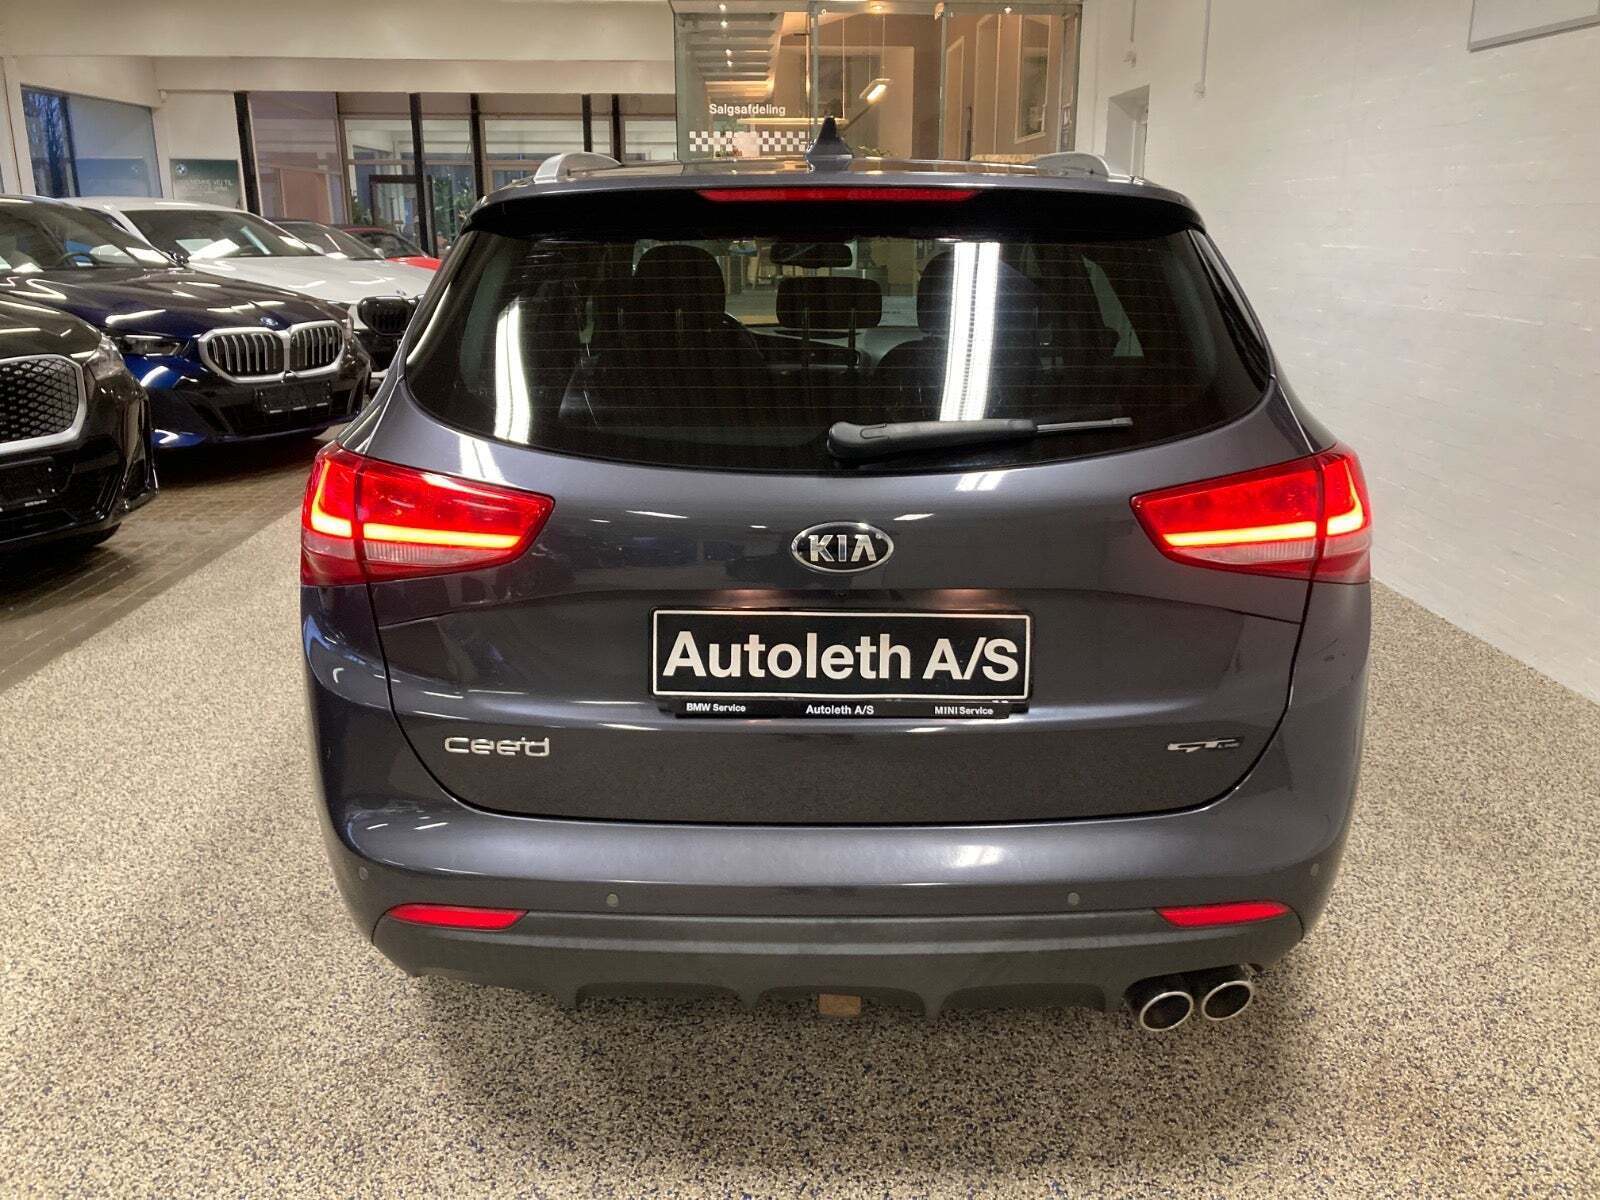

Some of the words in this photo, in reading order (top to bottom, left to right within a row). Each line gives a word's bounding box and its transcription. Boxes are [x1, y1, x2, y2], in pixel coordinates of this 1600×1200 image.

[709, 103, 786, 117] Salgsafdeling
[808, 534, 877, 562] KIA
[662, 630, 911, 680] Autoleth
[922, 636, 1019, 682] A/S
[686, 703, 711, 712] BMW
[713, 703, 746, 713] Service
[805, 704, 852, 715] Autoleth
[854, 705, 874, 715] A/S
[934, 706, 958, 715] MINI
[959, 706, 994, 715] Service
